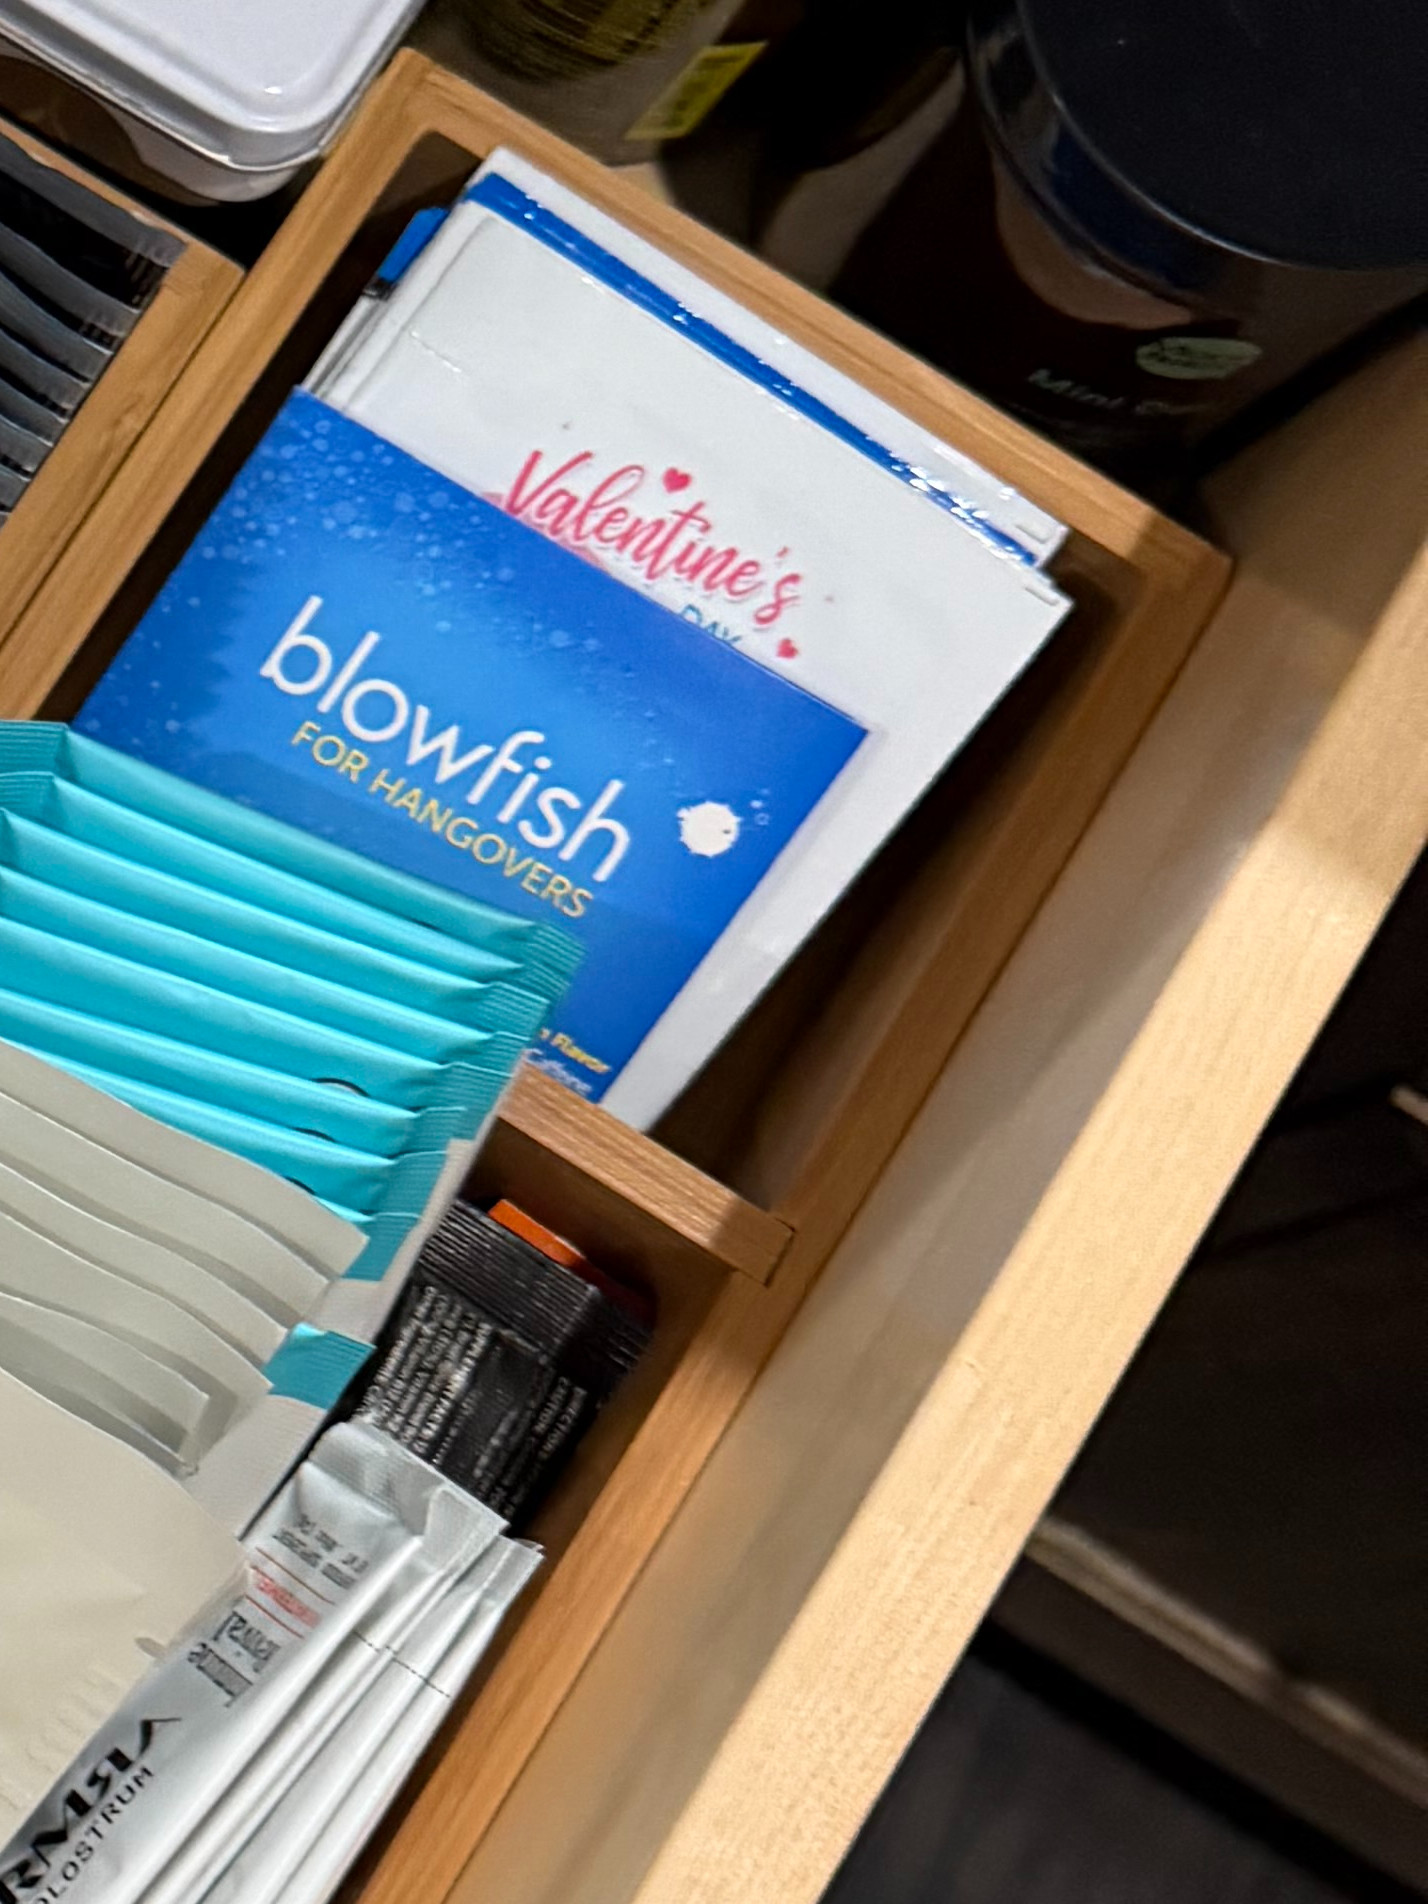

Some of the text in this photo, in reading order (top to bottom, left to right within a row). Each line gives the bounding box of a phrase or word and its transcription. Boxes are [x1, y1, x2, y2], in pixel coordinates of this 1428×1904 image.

[489, 449, 804, 626] Valentine's
[259, 594, 632, 883] blowfish
[291, 721, 594, 919] FOR HANGOVERS
